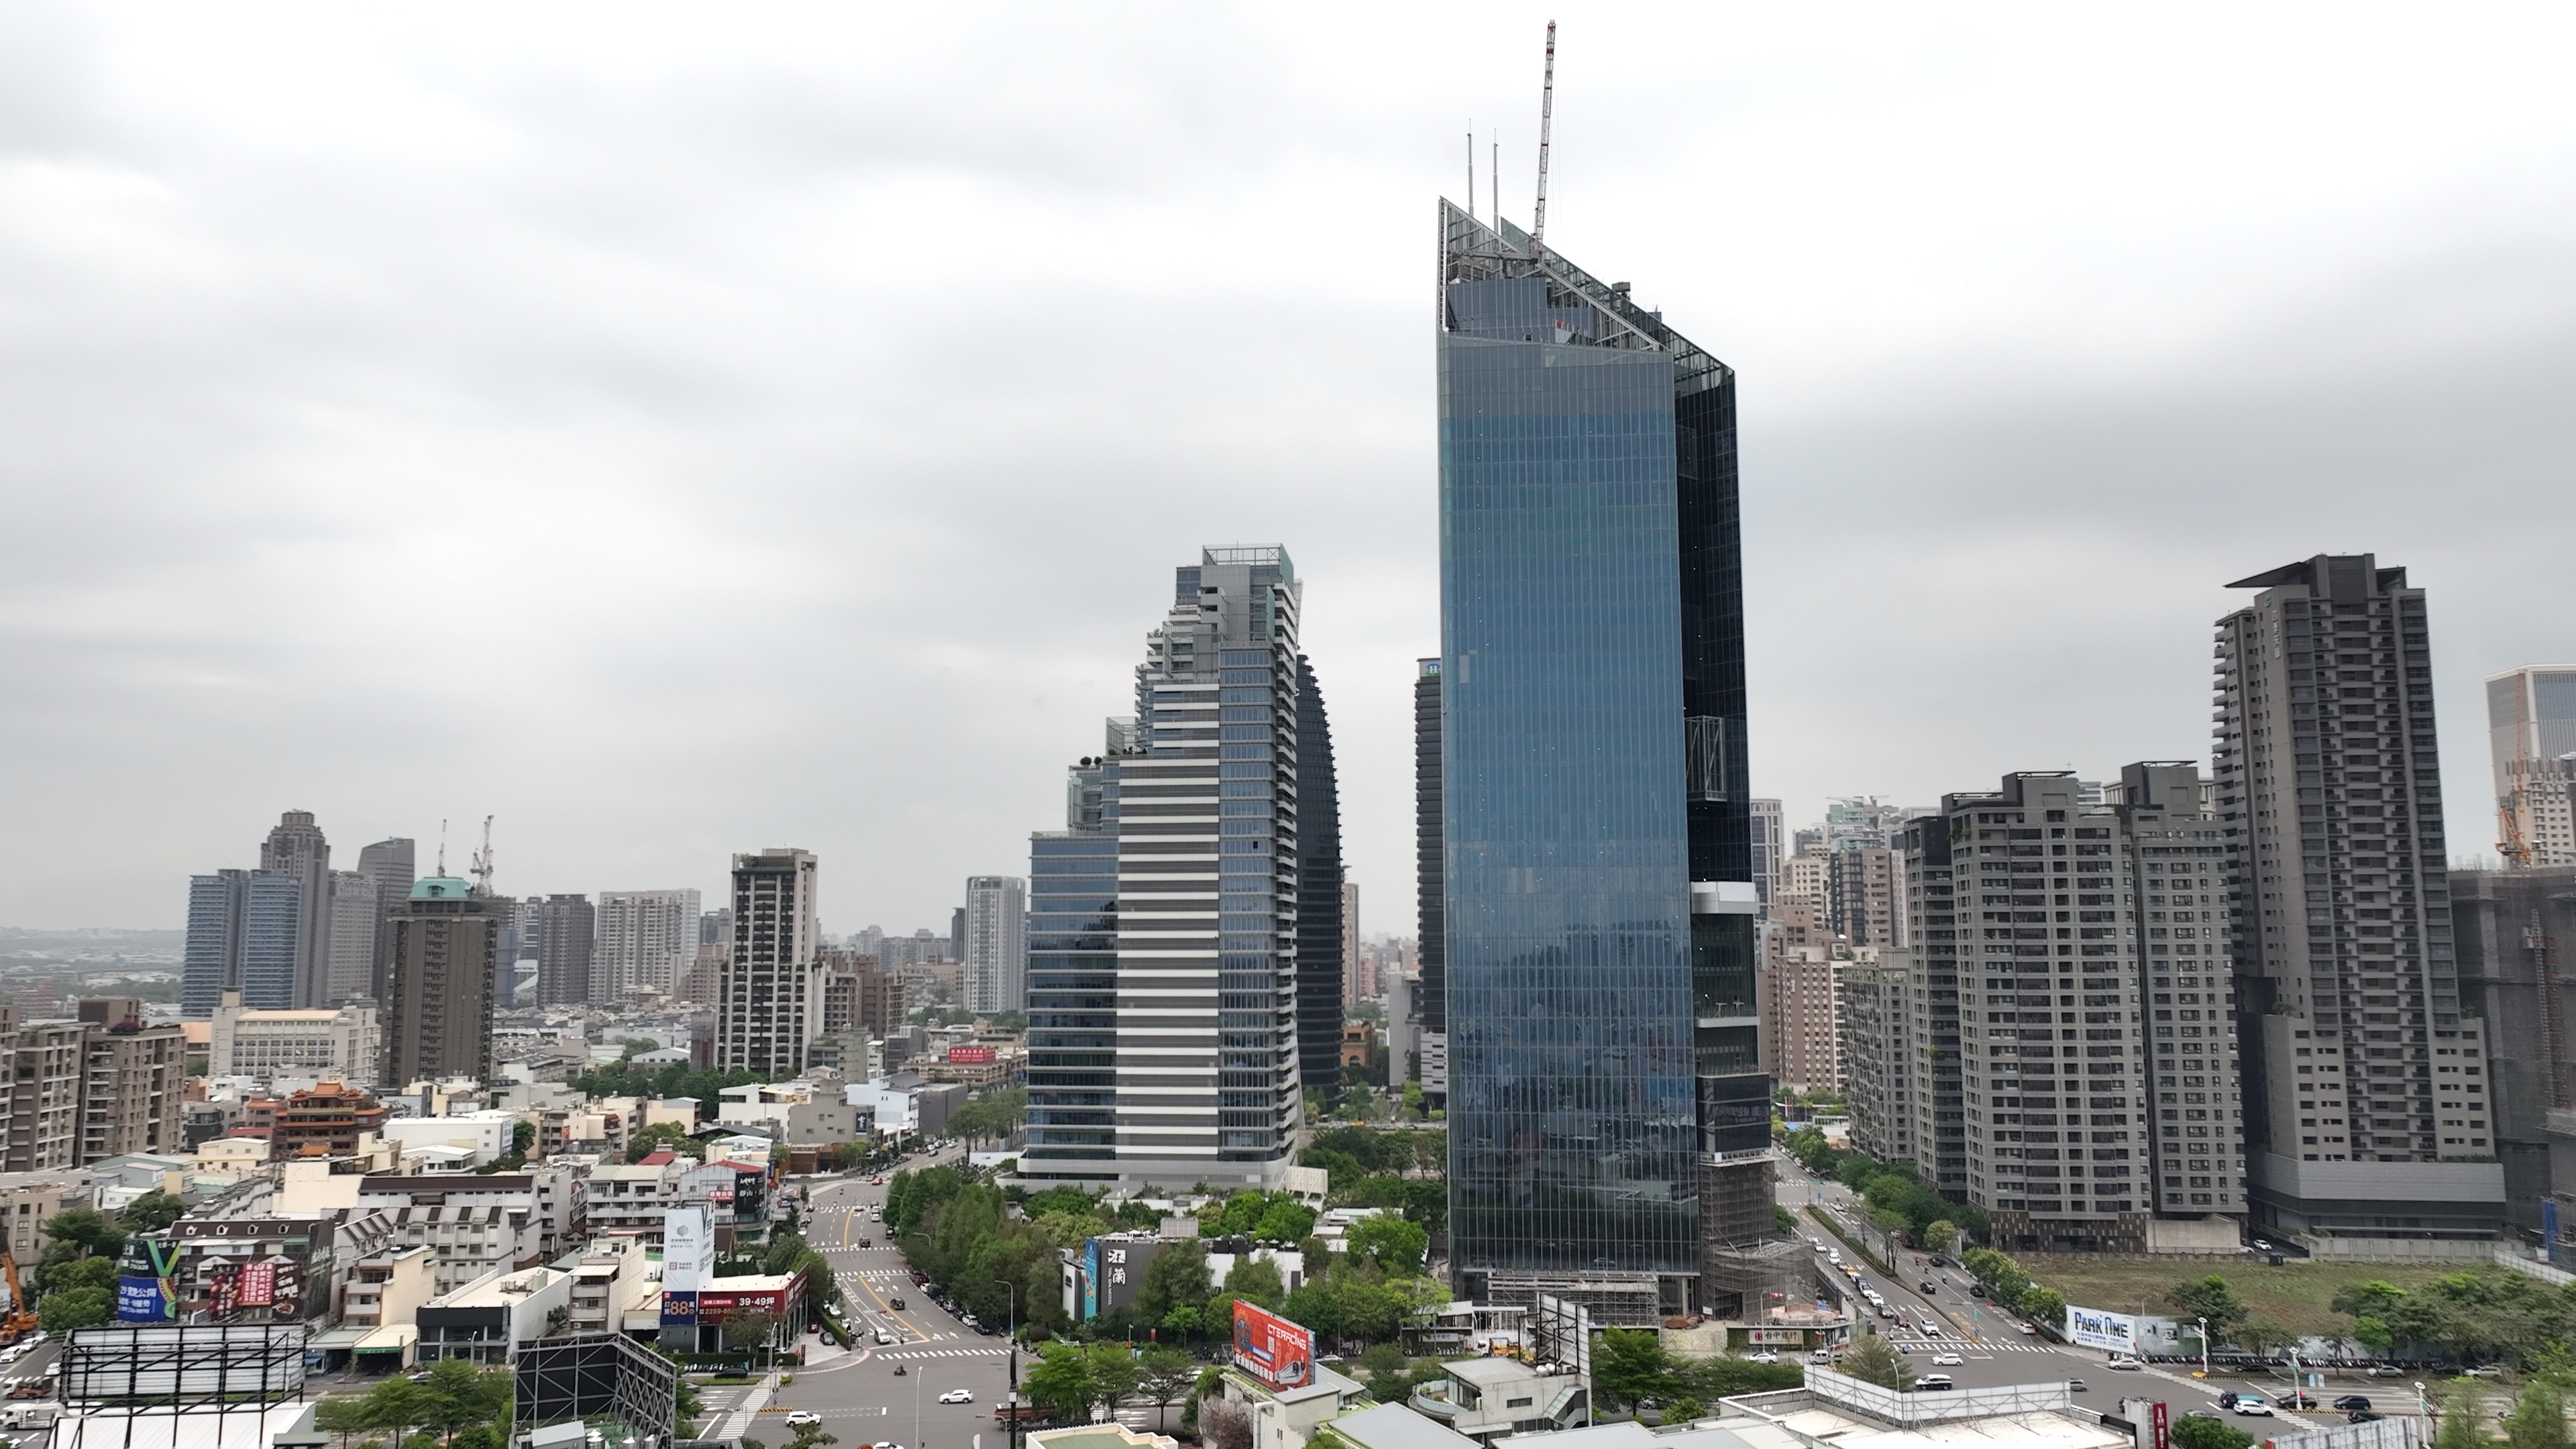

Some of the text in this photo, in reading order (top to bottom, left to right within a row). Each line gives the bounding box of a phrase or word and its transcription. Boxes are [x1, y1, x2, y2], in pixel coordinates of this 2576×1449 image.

[670, 1301, 689, 1316] 88
[1267, 1323, 1307, 1350] CTERACING
[1766, 1332, 1798, 1340] 台中銀行
